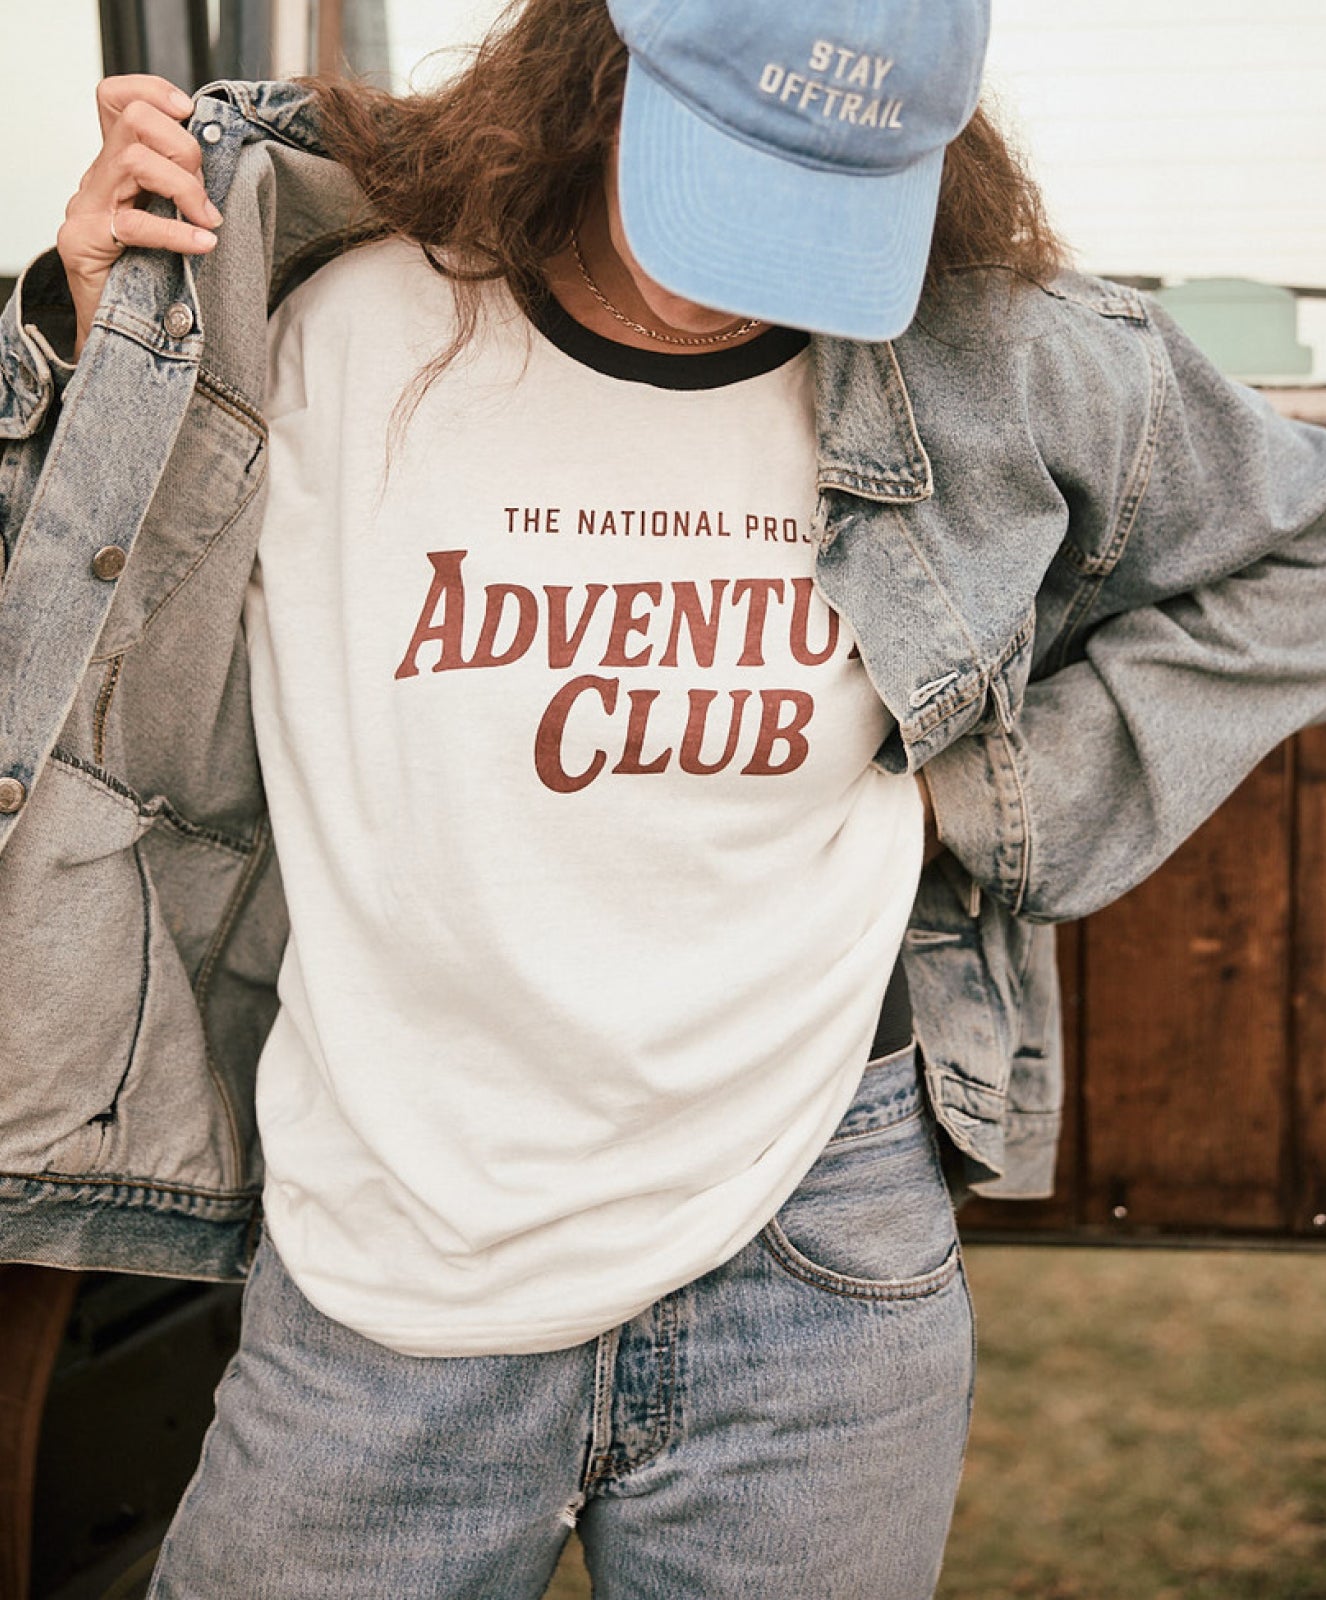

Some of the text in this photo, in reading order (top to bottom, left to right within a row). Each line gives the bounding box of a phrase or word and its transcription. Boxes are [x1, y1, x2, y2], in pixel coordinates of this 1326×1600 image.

[759, 64, 903, 128] OFFTRAIL
[809, 40, 894, 90] STAY
[504, 507, 561, 534] THE
[577, 509, 731, 538] NATIONAL
[394, 549, 861, 680] ADVENTU
[534, 674, 815, 794] CLUB
